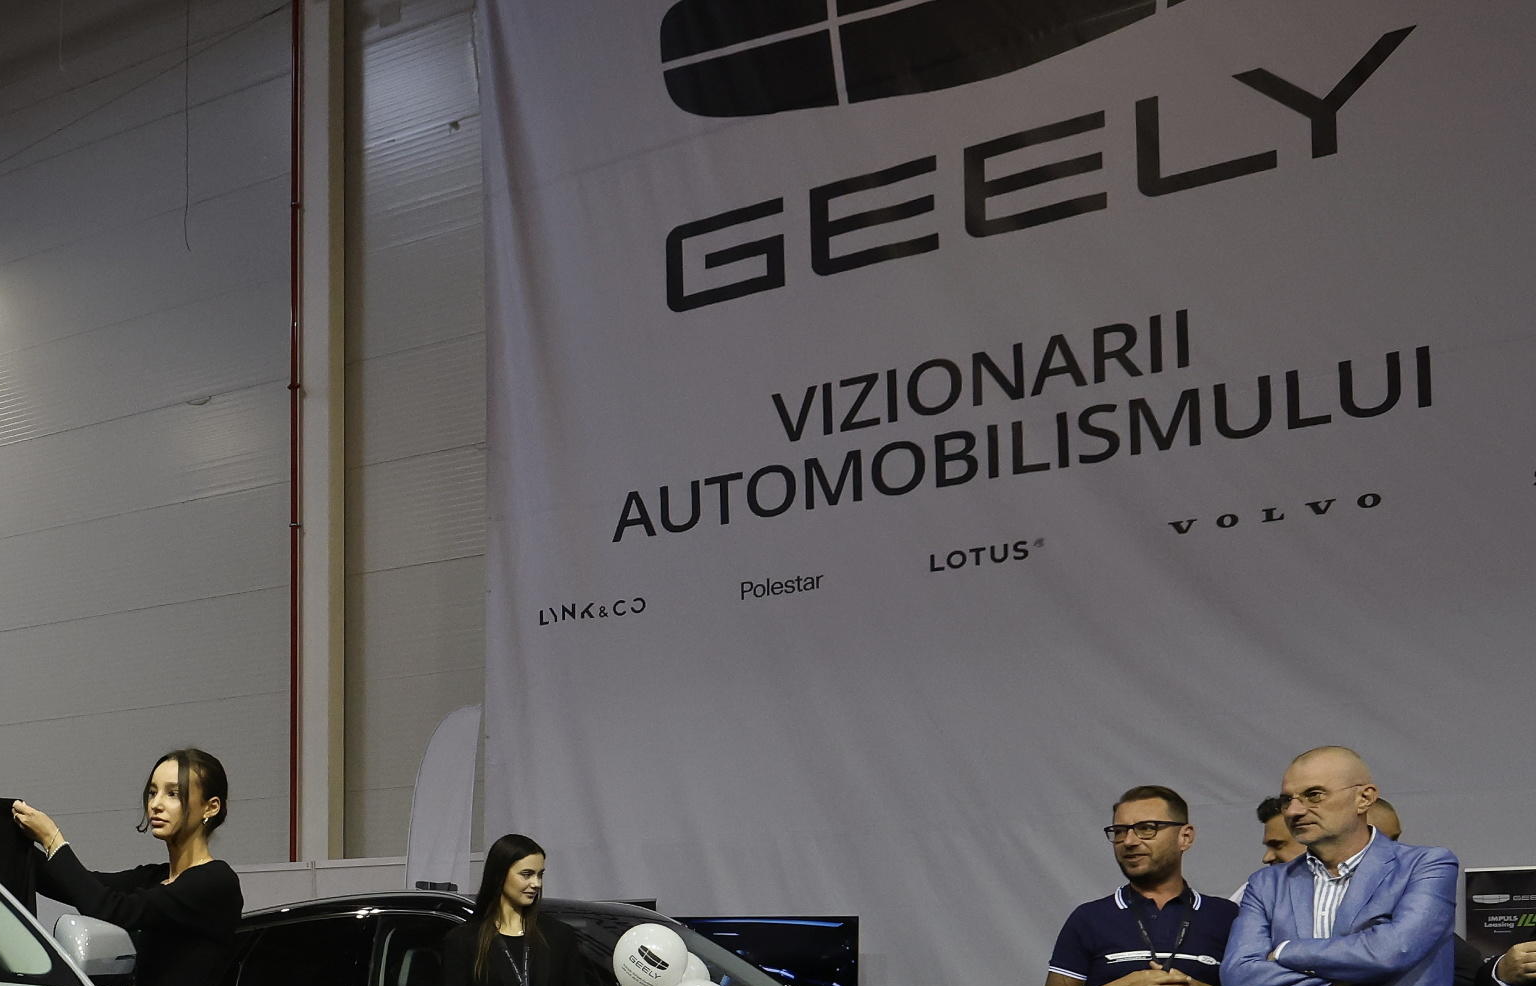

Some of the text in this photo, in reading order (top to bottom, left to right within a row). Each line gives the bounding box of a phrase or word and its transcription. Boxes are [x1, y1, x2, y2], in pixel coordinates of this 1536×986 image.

[666, 25, 1417, 312] GEELY
[772, 309, 1189, 442] VIZIONARII
[612, 346, 1432, 542] AUTOMOBILISMULUI
[1167, 493, 1382, 535] VOLVO
[929, 540, 1030, 572] LOTUS
[740, 574, 824, 600] Polestar
[628, 954, 661, 980] GEELY
